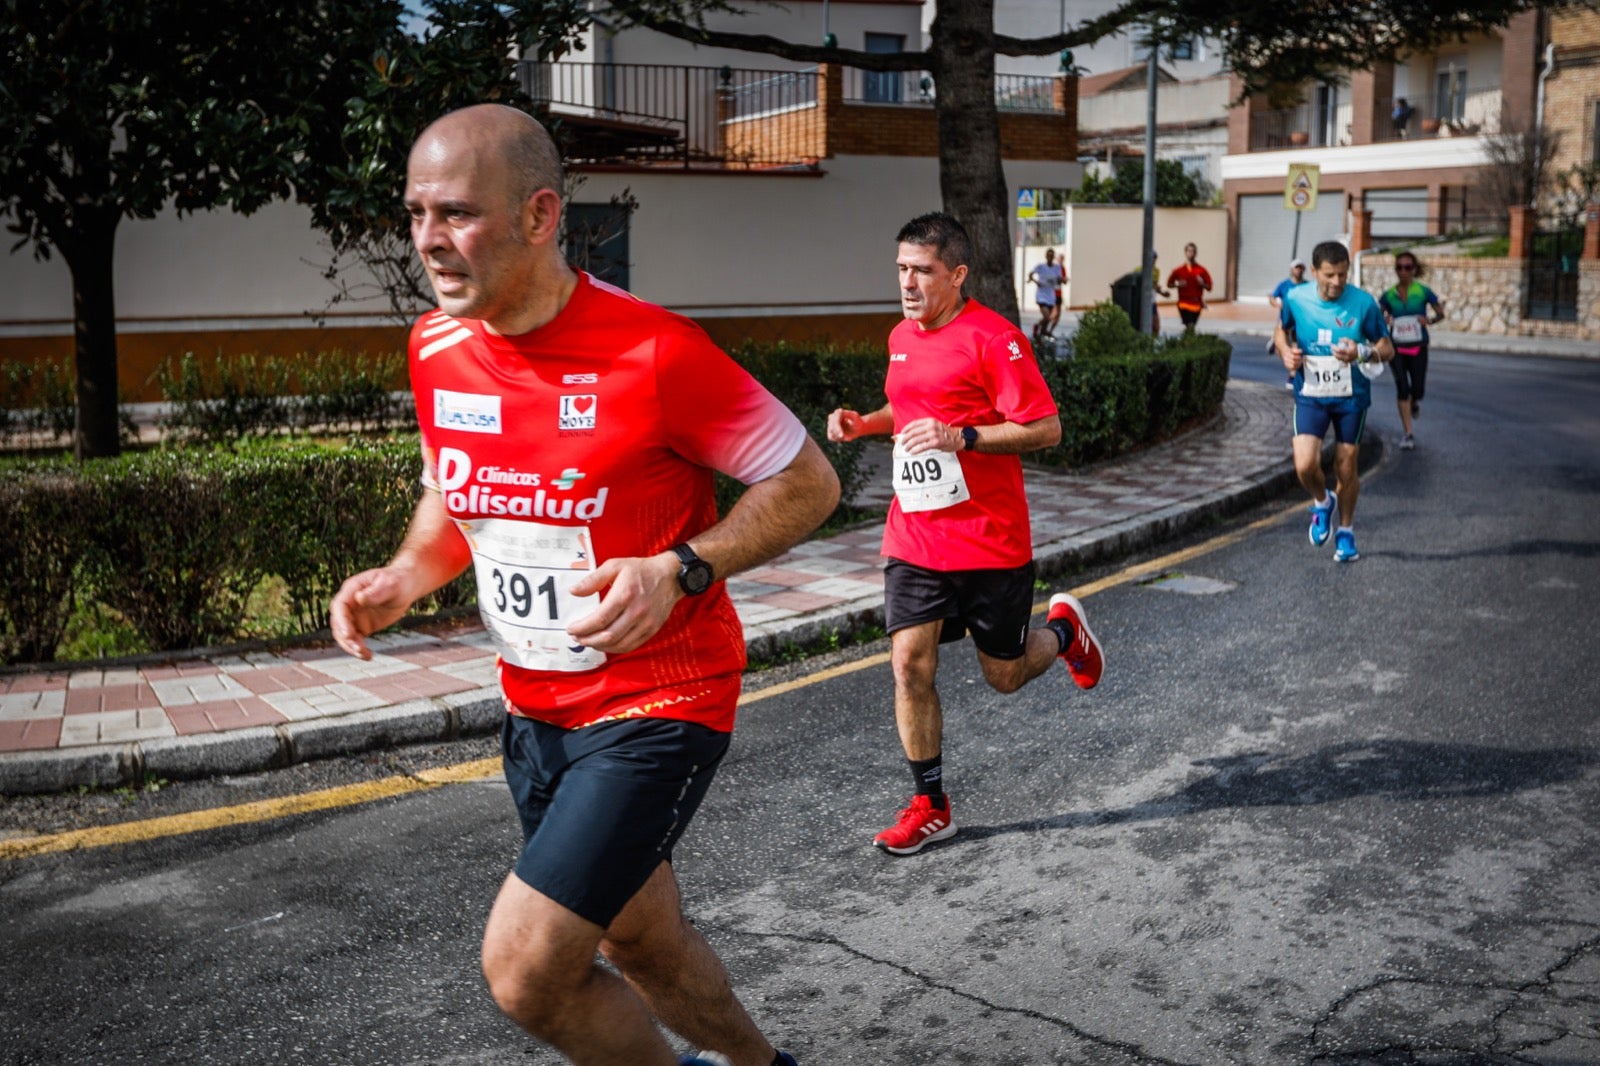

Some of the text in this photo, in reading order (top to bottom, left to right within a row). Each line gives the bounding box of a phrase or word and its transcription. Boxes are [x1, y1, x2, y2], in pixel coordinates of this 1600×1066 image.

[1314, 371, 1341, 383] 165
[564, 397, 570, 416] I
[902, 458, 942, 484] 409
[492, 568, 558, 620] 391
